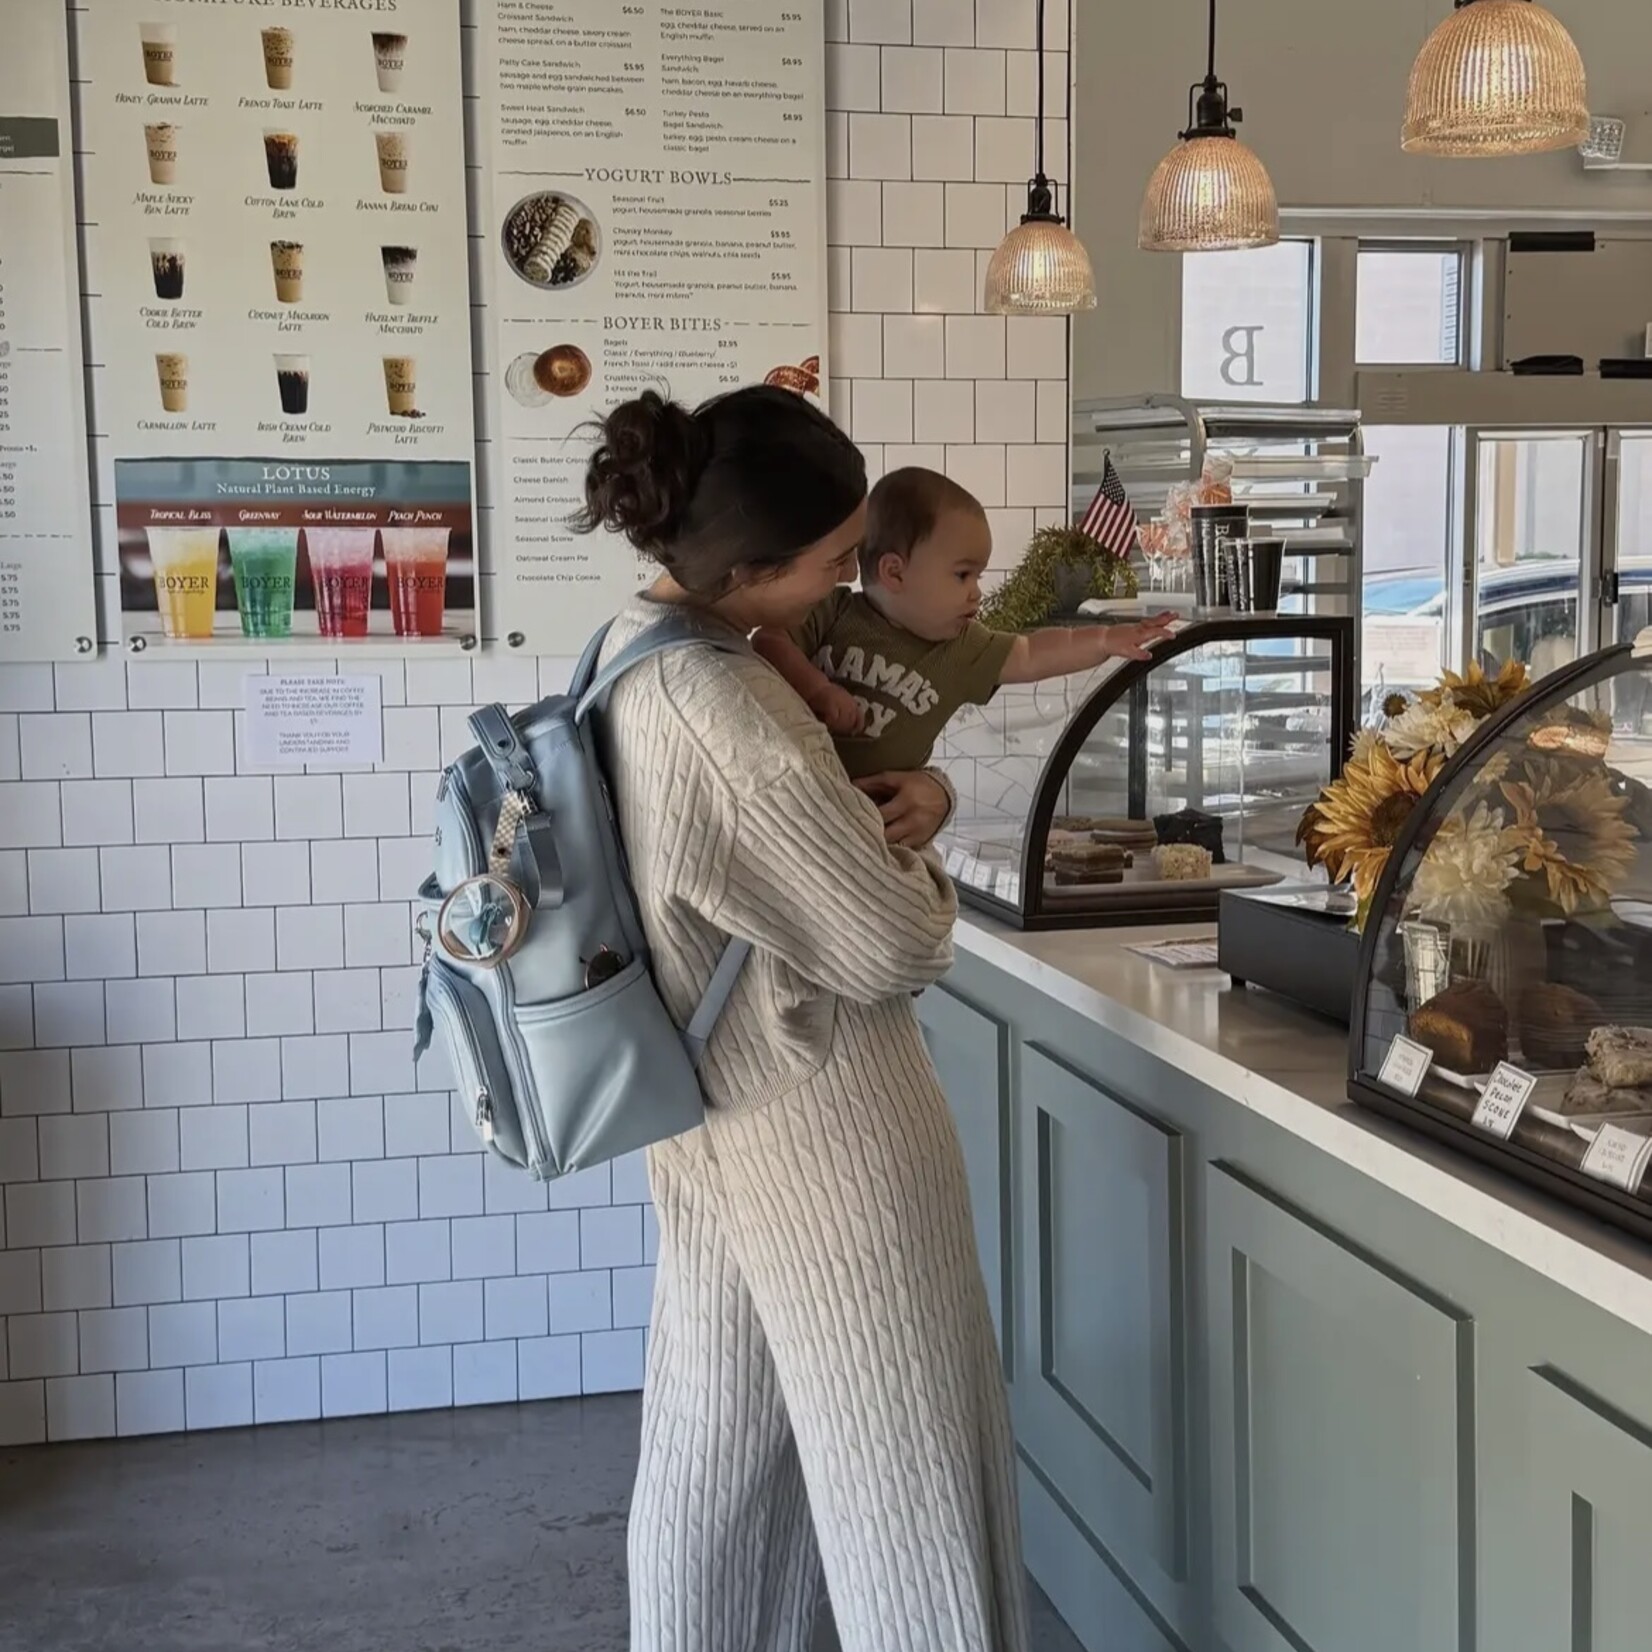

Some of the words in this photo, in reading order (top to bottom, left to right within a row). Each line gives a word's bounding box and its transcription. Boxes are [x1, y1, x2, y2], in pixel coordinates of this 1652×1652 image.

[535, 14, 574, 22] Sandwich
[661, 53, 702, 63] Everything
[542, 60, 581, 68] Sandwich
[661, 65, 699, 73] Sandwich
[115, 93, 143, 104] HONEY
[183, 95, 209, 106] LATTE
[238, 97, 270, 108] FRENCH
[272, 98, 296, 109] TOAST
[298, 100, 323, 110] LATTE
[663, 110, 687, 118] Turkey
[689, 110, 710, 118] Pesto
[585, 168, 664, 184] YOGURT
[671, 171, 732, 186] BOWLS
[301, 198, 324, 208] COLD
[612, 195, 646, 203] Seasonal
[165, 204, 190, 215] LATTE
[272, 209, 296, 219] BREW
[612, 227, 642, 236] Chunky
[644, 228, 672, 237] Monkey
[146, 319, 168, 328] COLD
[172, 319, 196, 329] BREW
[278, 322, 302, 332] LATTE
[603, 316, 665, 330] BOYER
[671, 318, 721, 332] BITES
[137, 420, 188, 430] CARMALLOW
[191, 420, 217, 431] LATTE
[309, 422, 331, 432] COLD
[282, 432, 306, 442] BREW
[394, 434, 418, 444] LATTE
[262, 466, 330, 480] LOTUS
[216, 484, 260, 494] Natural
[264, 484, 294, 494] Plant
[298, 484, 330, 494] Based
[334, 484, 376, 497] Energy
[150, 510, 186, 520] TROPICAL
[238, 510, 282, 521] GREENWAY
[324, 508, 378, 520] WATERMELON
[158, 576, 209, 590] BOYER
[242, 576, 291, 590] BOYER
